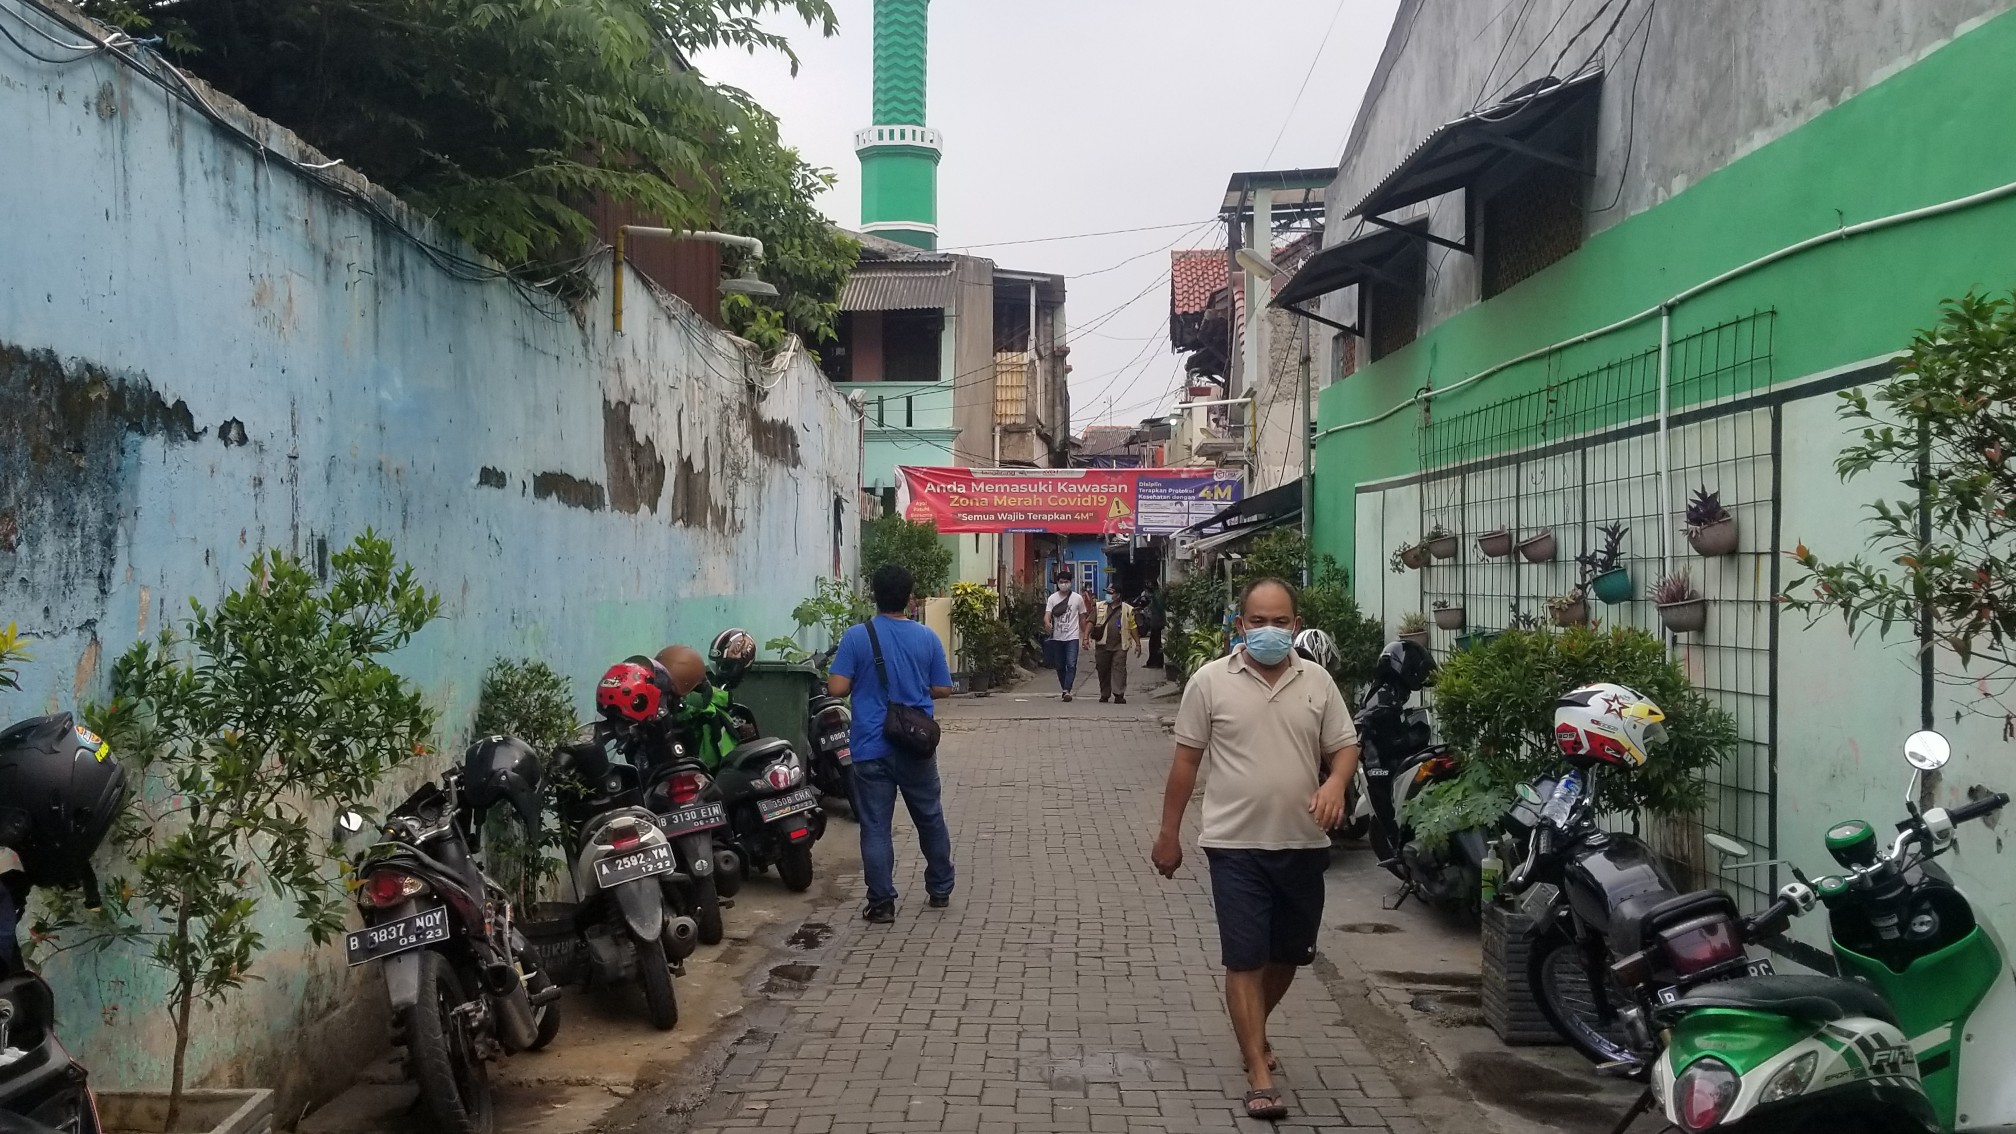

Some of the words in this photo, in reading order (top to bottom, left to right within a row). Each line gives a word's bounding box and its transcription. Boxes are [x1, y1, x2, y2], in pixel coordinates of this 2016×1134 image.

[925, 481, 966, 493] Anda
[971, 481, 1052, 493] Memasuki
[1057, 482, 1128, 493] Kawasan
[1199, 485, 1232, 500] 4M
[949, 495, 988, 507] Zona
[993, 494, 1042, 507] Merah
[1047, 494, 1107, 506] Covid19
[957, 512, 995, 521] "Semua
[997, 512, 1025, 522] Wajib
[1027, 512, 1072, 521] Terapkan
[761, 803, 768, 812] B
[660, 817, 667, 827] B
[672, 810, 697, 824] 3130
[700, 805, 720, 818] EIN
[601, 863, 610, 876] A
[615, 852, 647, 871] 2592
[651, 847, 669, 860] YM
[350, 936, 360, 951] B
[369, 923, 406, 943] 3837
[415, 911, 442, 929] NQY
